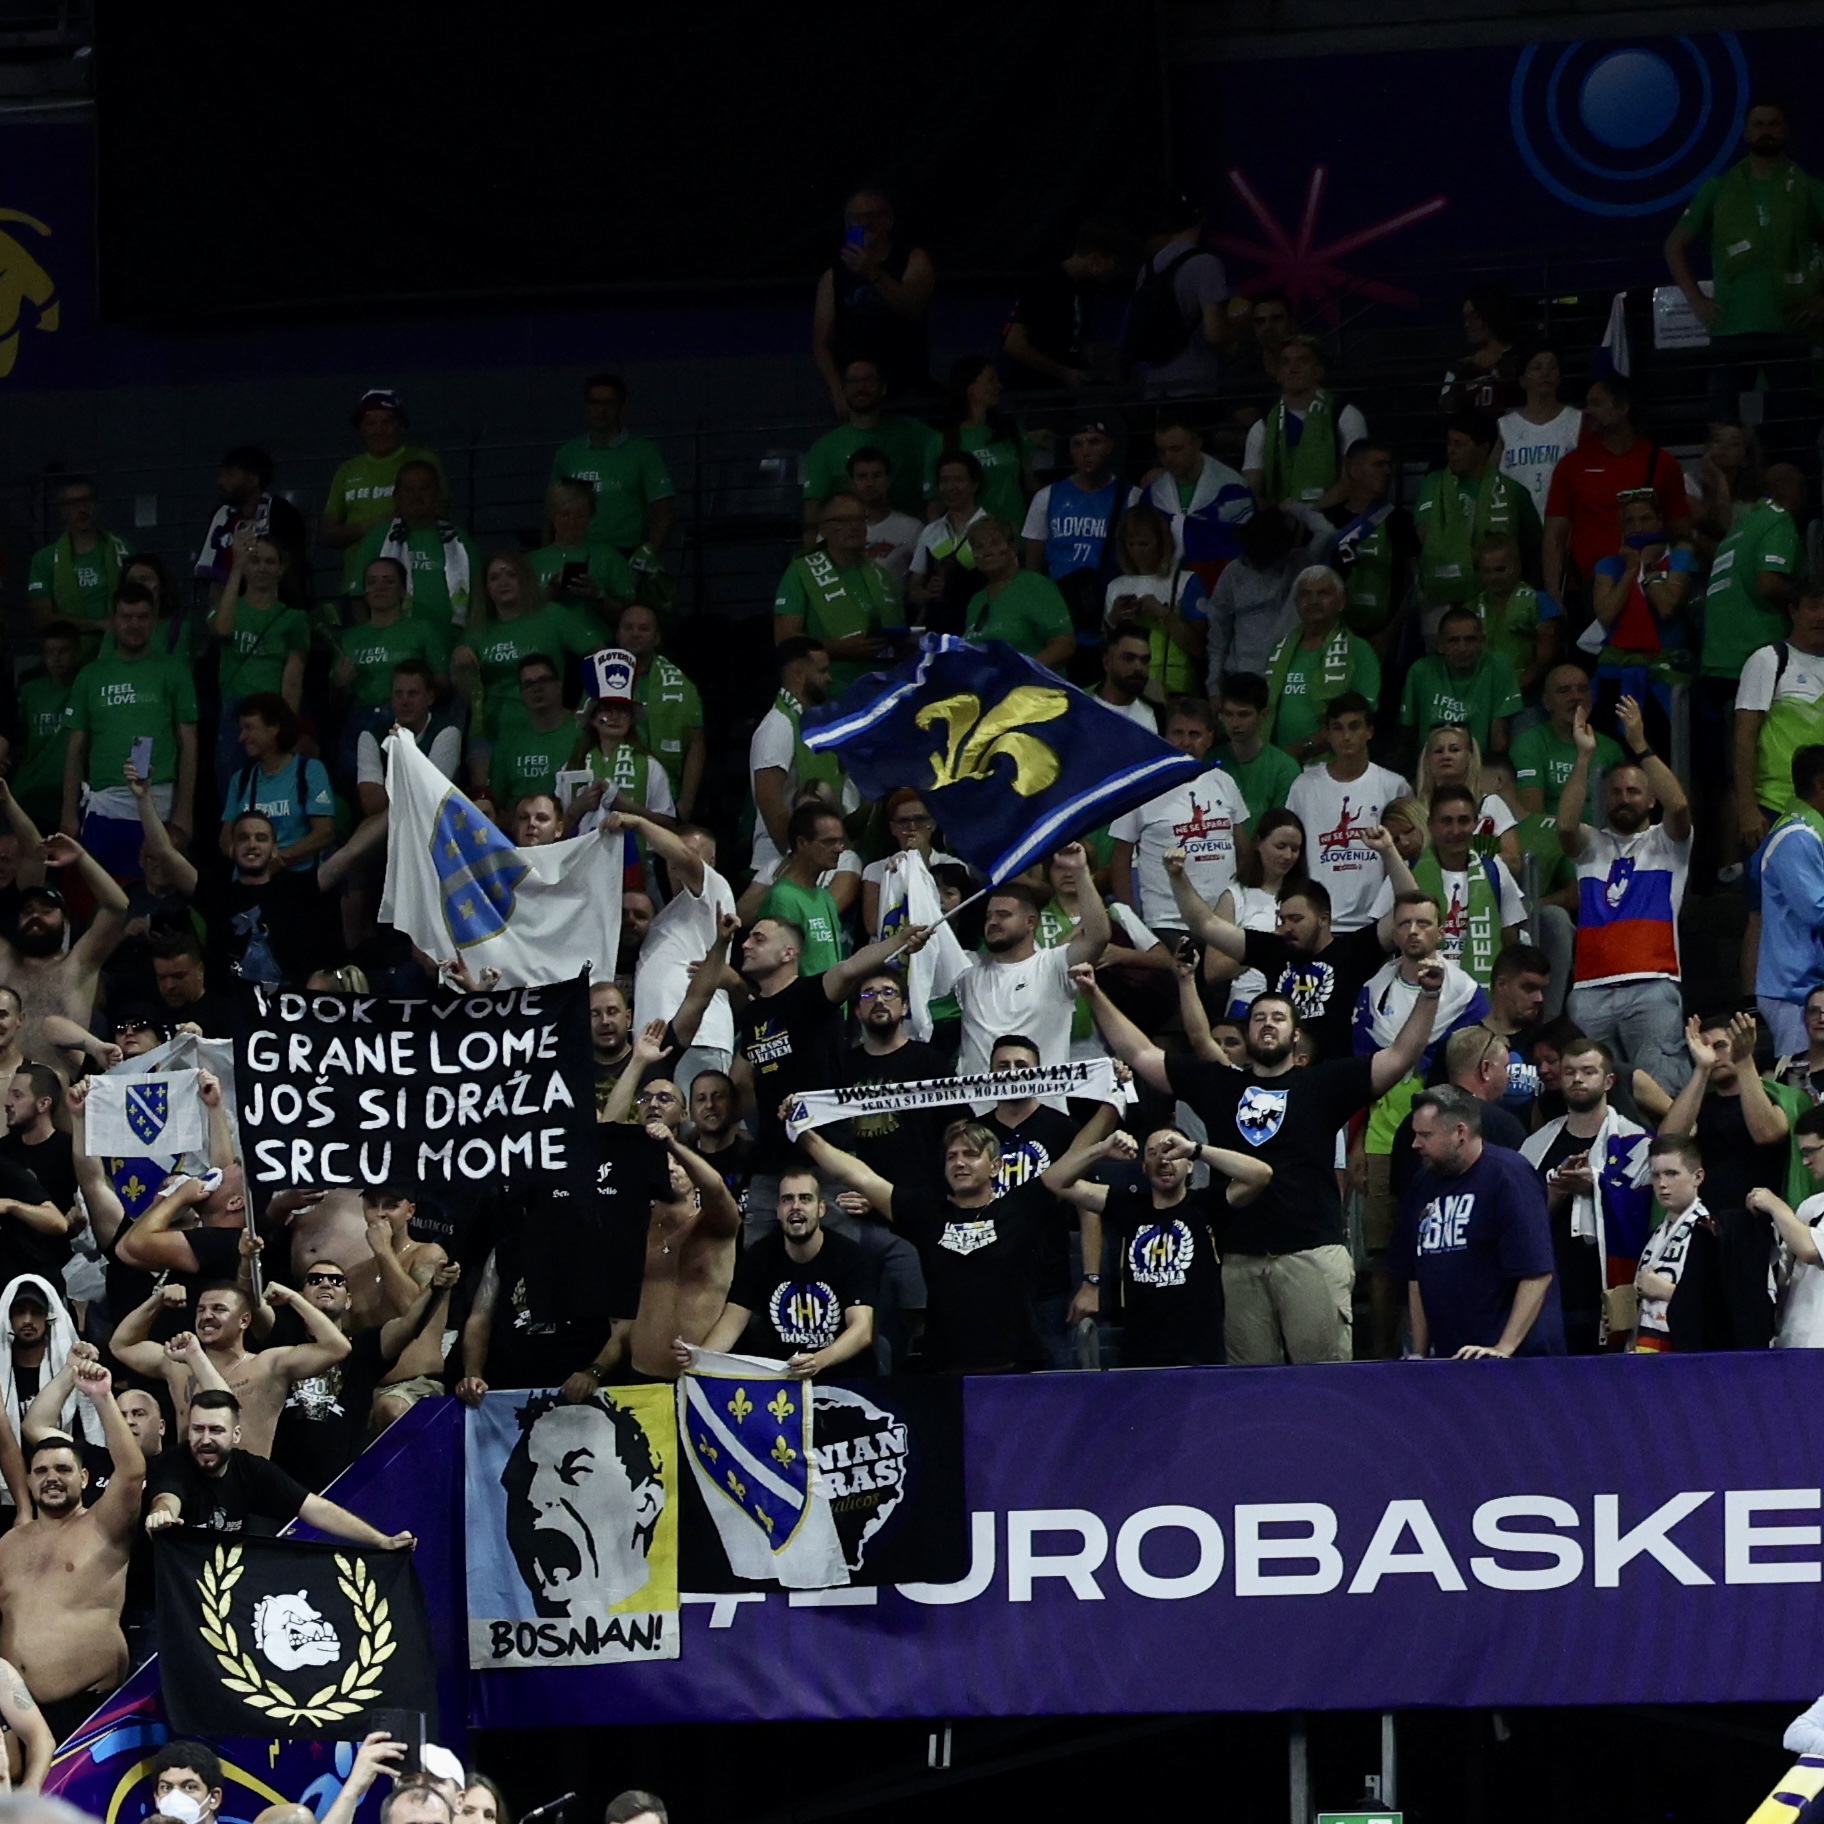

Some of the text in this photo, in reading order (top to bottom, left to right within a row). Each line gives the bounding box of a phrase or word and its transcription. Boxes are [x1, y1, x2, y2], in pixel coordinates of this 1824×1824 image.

[1071, 542, 1092, 563] 77
[107, 683, 134, 695] FEEL
[1285, 683, 1308, 695] OVE
[1287, 672, 1305, 684] EEL
[1320, 847, 1380, 864] SLOVENIJA
[279, 992, 379, 1024] DOK
[388, 988, 545, 1023] TVOJE
[246, 1021, 560, 1077] GRANE LOME
[244, 1074, 337, 1131] JOŠ
[357, 1086, 408, 1131] SI
[975, 1083, 1009, 1098] MOJA
[253, 1137, 356, 1185] SRCU
[417, 1126, 569, 1182] MOME
[1432, 1193, 1476, 1221] AND
[410, 1216, 455, 1235] ANATICOS
[1425, 1220, 1470, 1250] ONE
[1134, 1270, 1187, 1286] BOSNIA
[815, 1424, 903, 1475] NIAN
[788, 1487, 1822, 1608] UROBASKE
